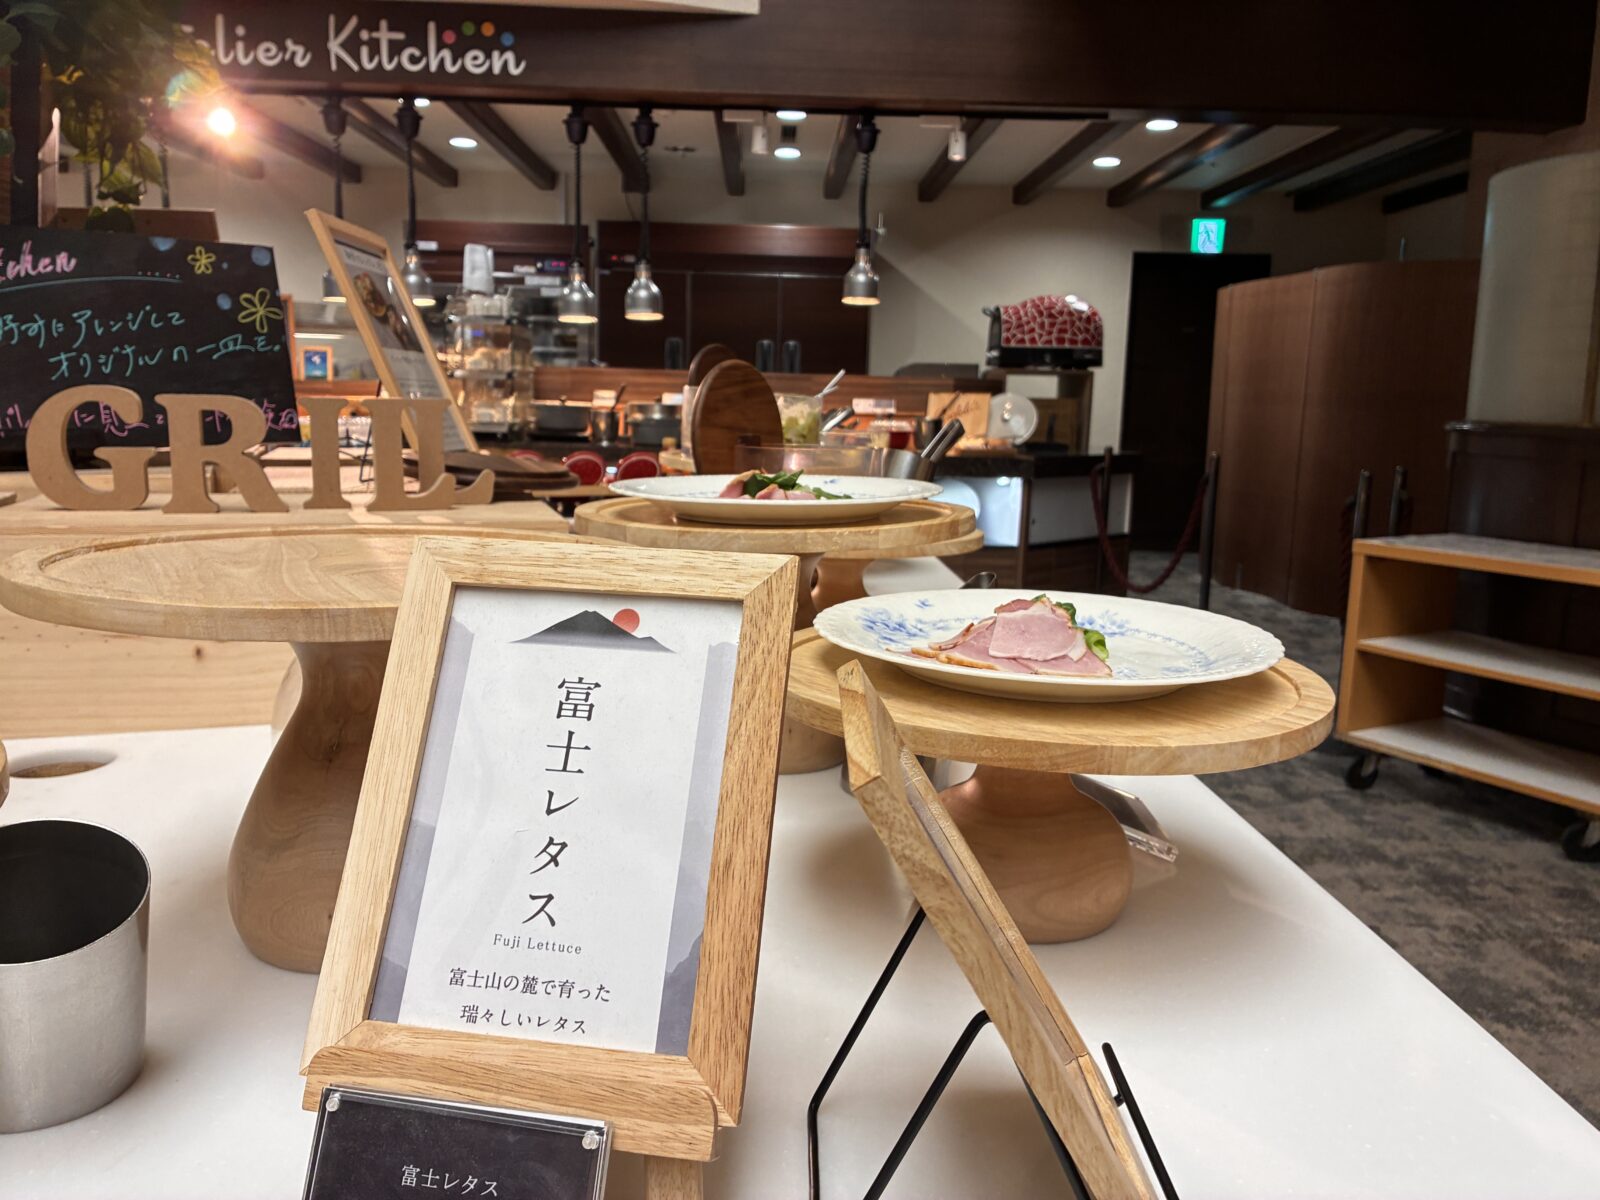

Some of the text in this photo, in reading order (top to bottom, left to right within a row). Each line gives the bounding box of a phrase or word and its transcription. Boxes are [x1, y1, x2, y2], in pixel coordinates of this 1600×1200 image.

[327, 14, 526, 76] Kitchen
[521, 676, 602, 927] 富士レタス
[493, 933, 582, 955] Fuji Lettuce
[448, 967, 611, 1002] 富士山の麓で育った
[459, 1003, 587, 1035] 瑞々しいレタス
[400, 1164, 499, 1197] 富士レタス
